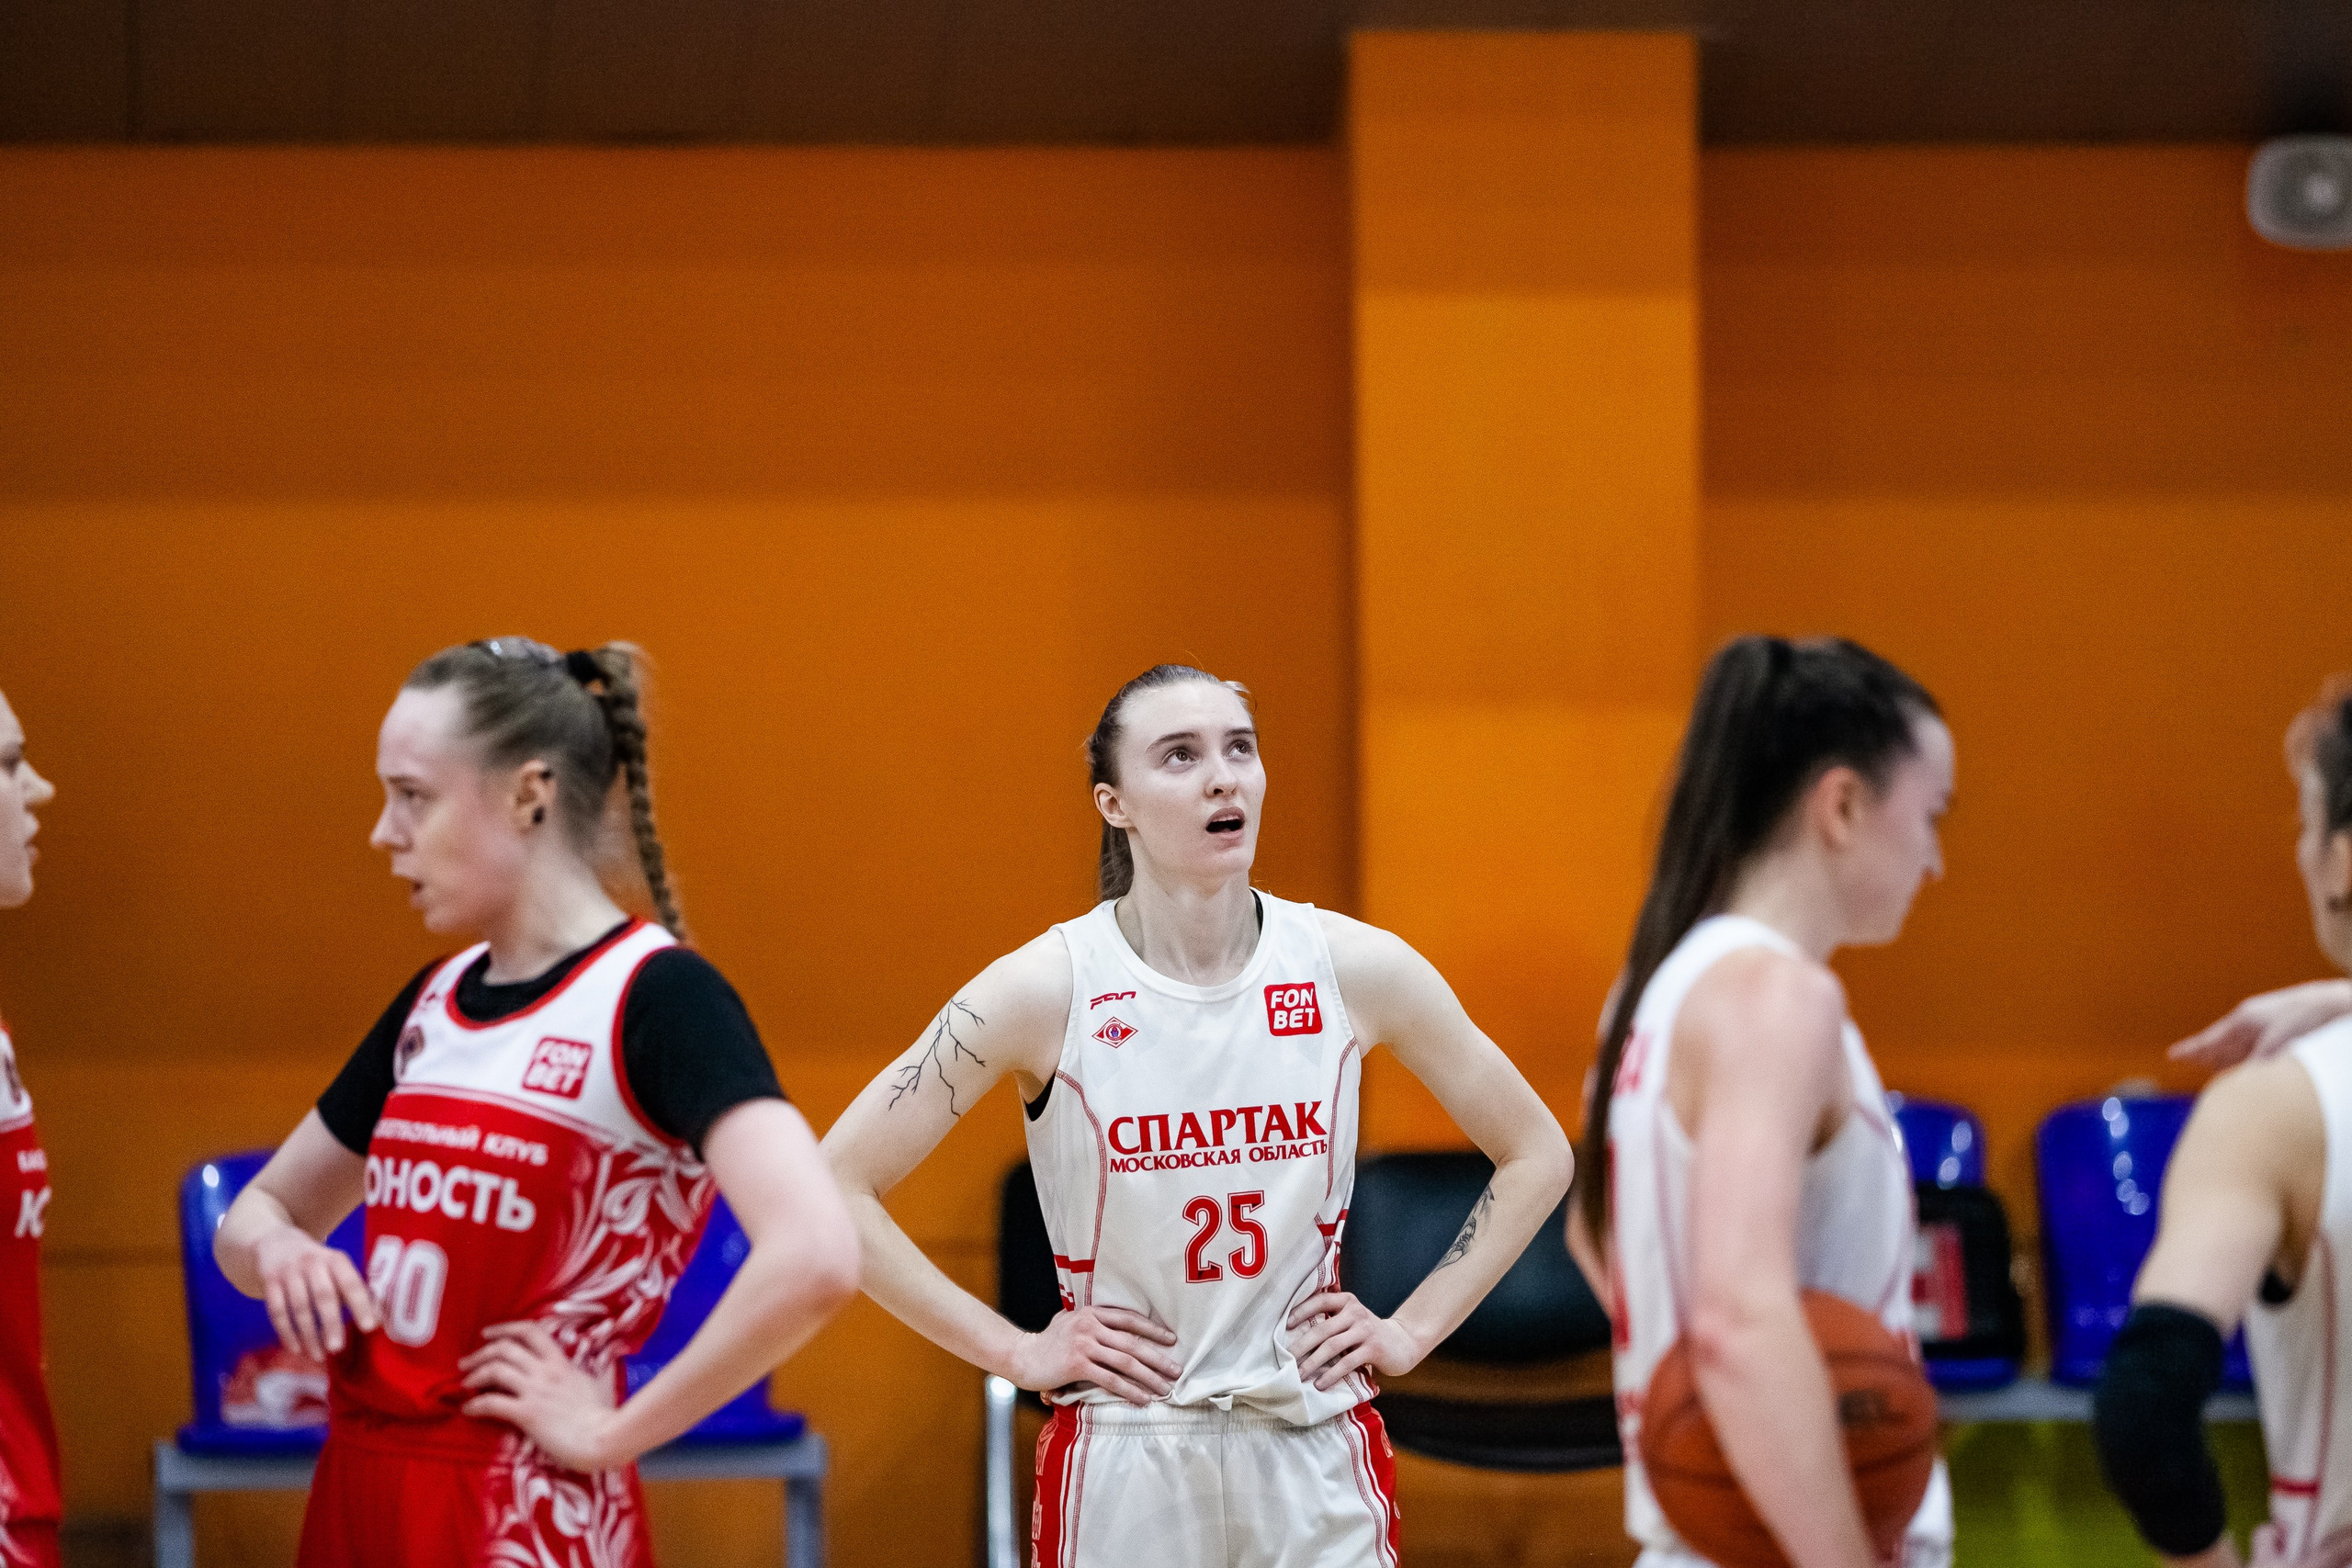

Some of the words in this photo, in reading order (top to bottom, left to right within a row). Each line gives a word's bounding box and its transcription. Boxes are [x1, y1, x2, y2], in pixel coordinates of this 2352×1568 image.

[1271, 987, 1314, 1009] FON
[1273, 1008, 1316, 1030] BET
[1108, 1100, 1328, 1155] СПАРТАК
[1110, 1148, 1241, 1173] МОСКОВСКАЯ
[1249, 1139, 1329, 1162] ОБЛАСТЬ
[1182, 1190, 1269, 1283] 25
